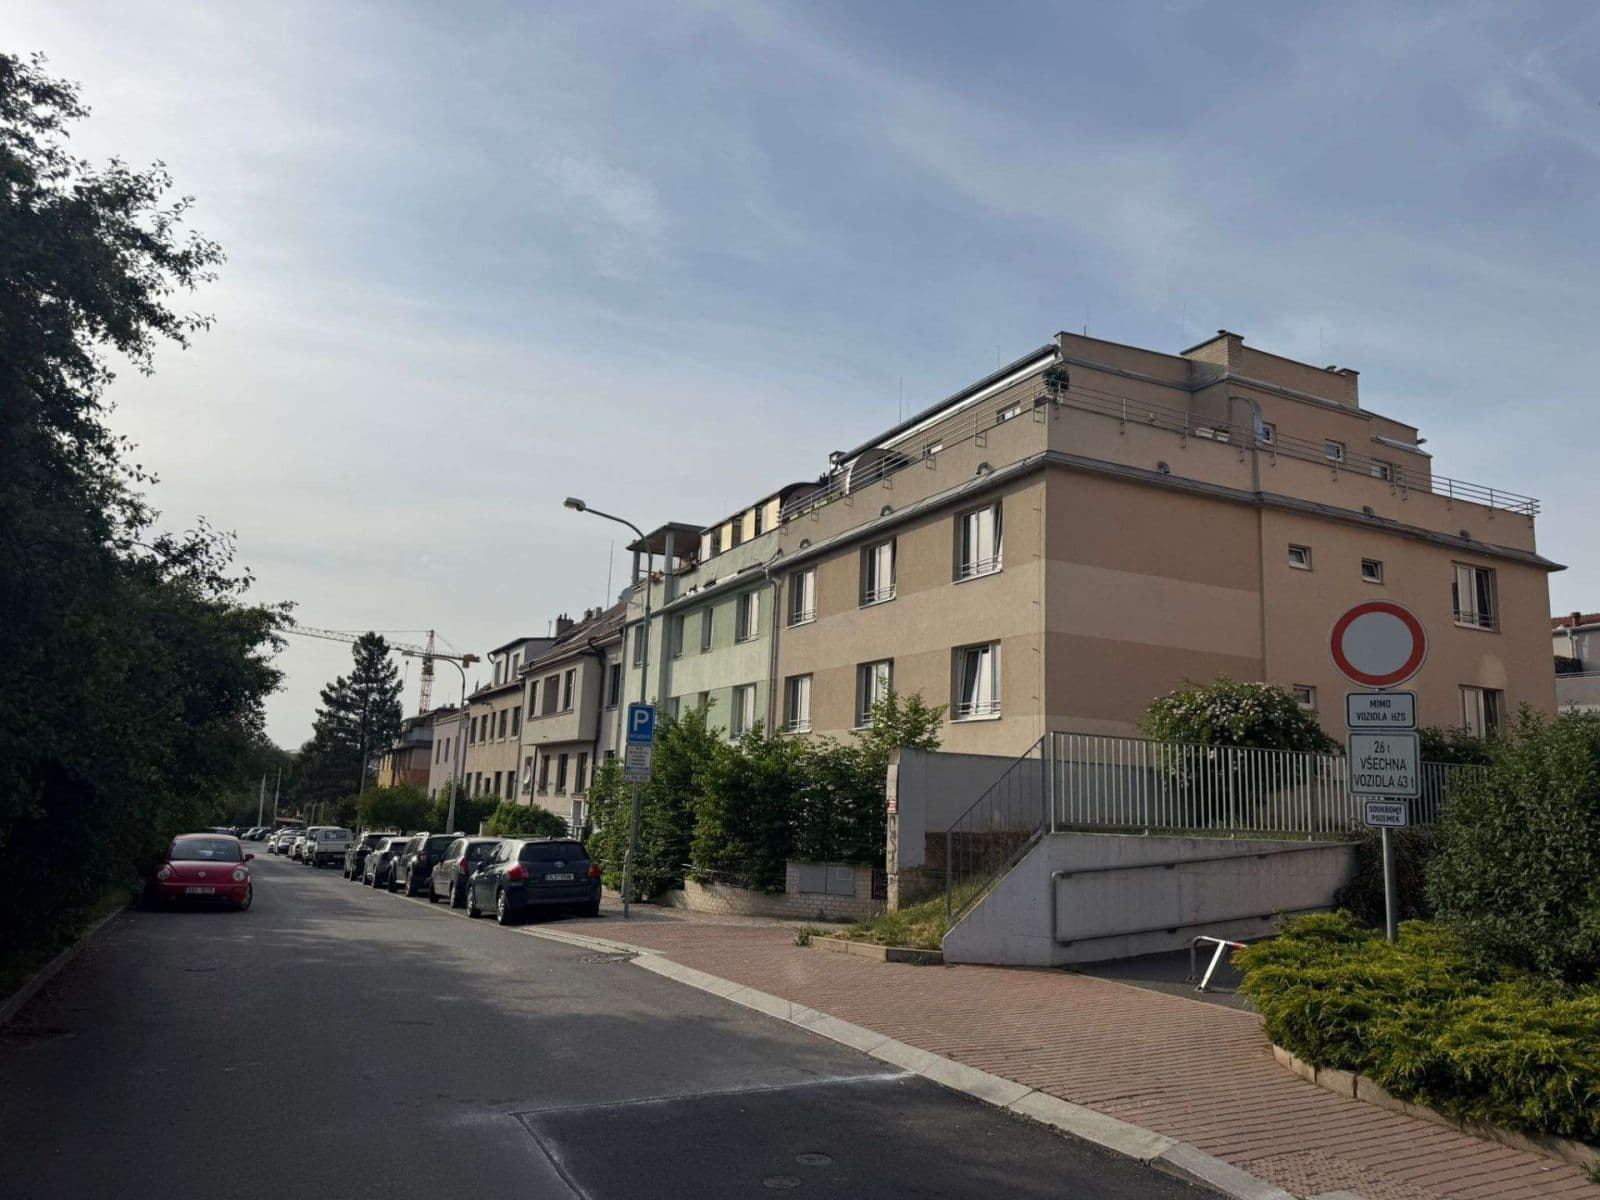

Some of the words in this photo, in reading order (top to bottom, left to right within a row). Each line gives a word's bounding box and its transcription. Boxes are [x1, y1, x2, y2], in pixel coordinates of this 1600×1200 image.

[1369, 699, 1391, 709] MIMO
[634, 709, 649, 731] P
[1356, 712, 1387, 721] VOZIDLA
[1391, 712, 1406, 722] HZS
[1374, 740, 1385, 754] 26
[1360, 755, 1407, 771] VŠECHNA
[1354, 774, 1395, 788] VOZIDLA
[1397, 776, 1408, 789] 43
[1371, 814, 1400, 822] POZEMEK
